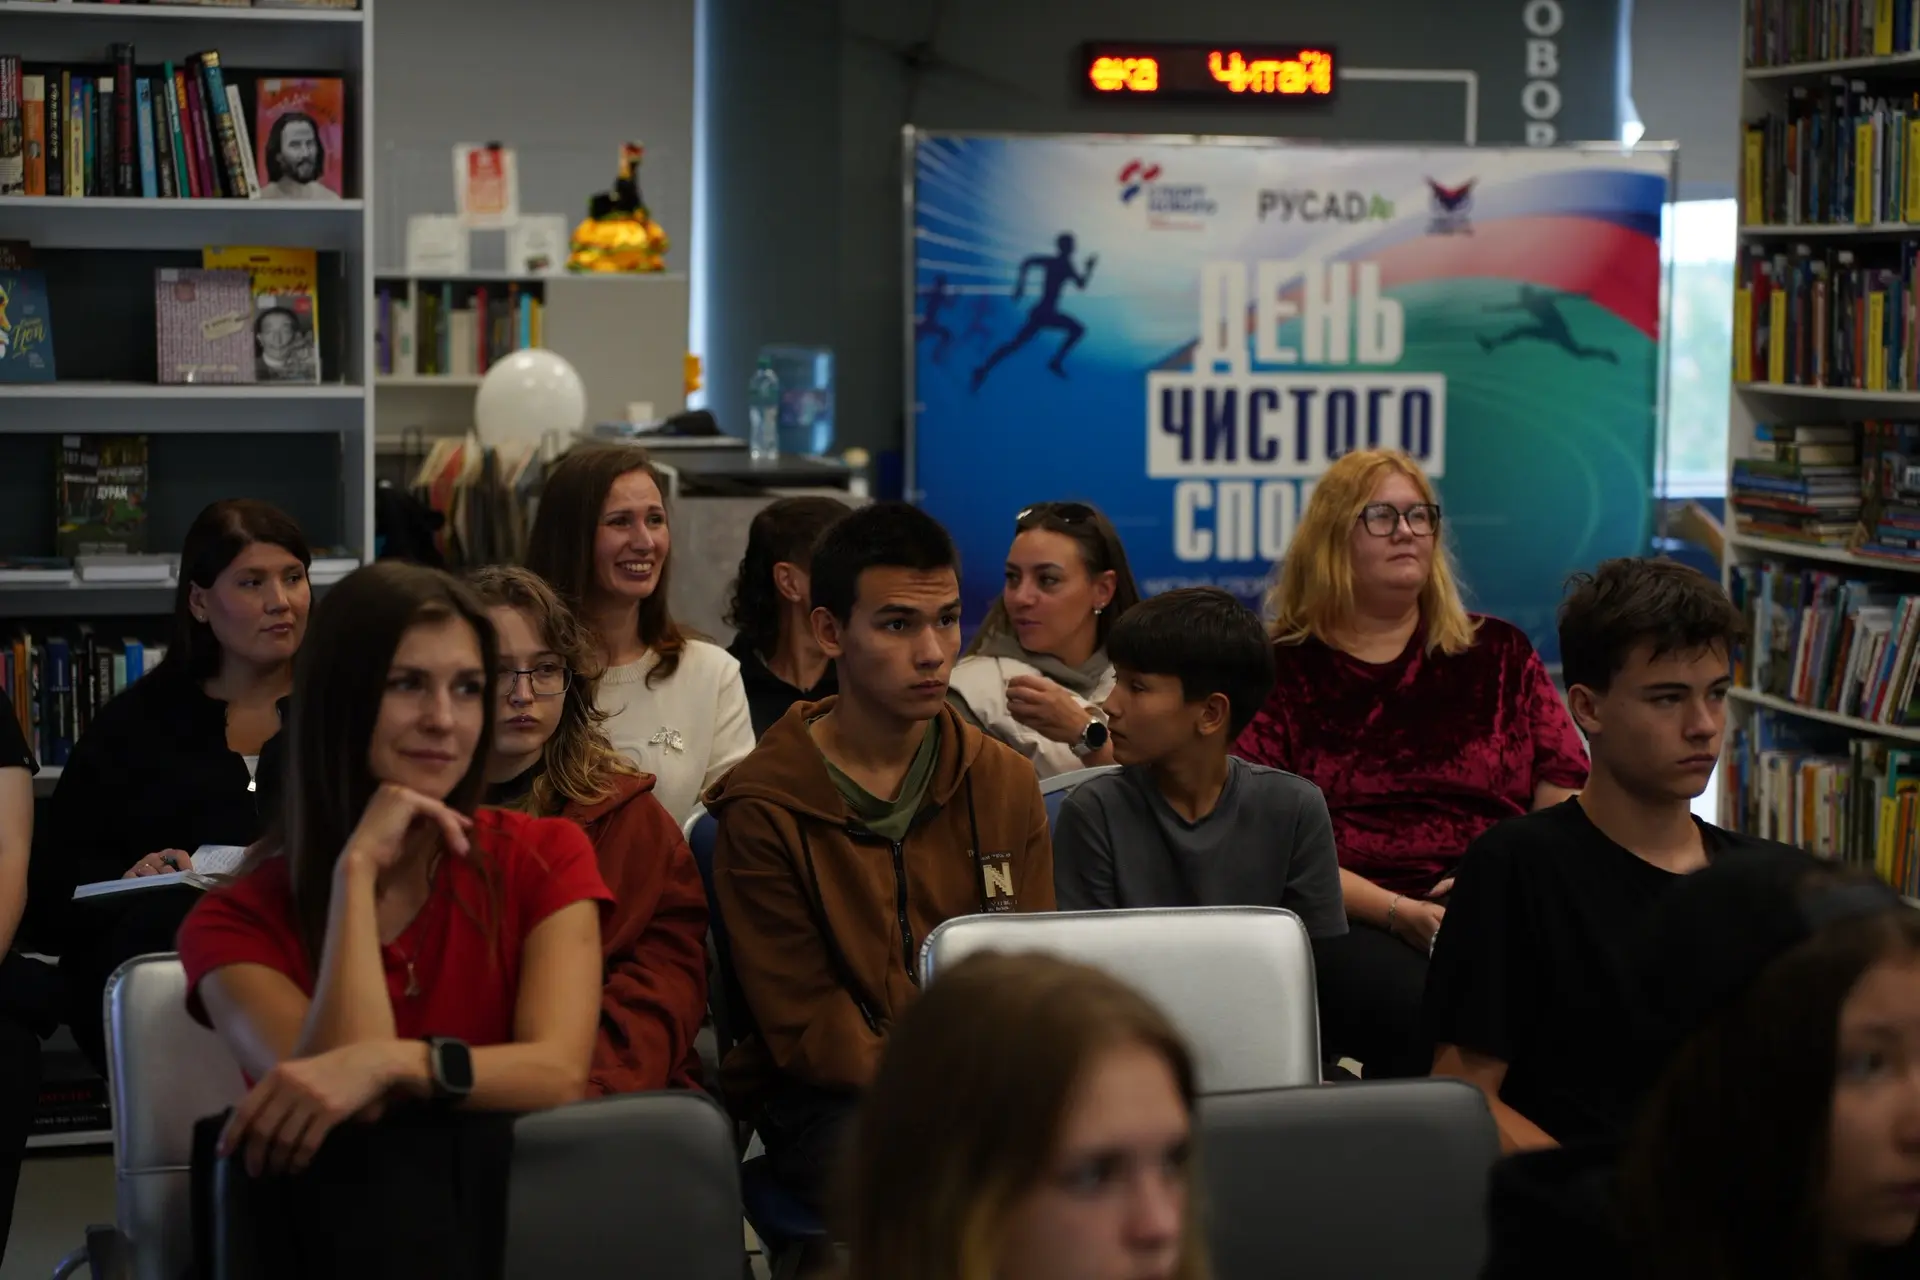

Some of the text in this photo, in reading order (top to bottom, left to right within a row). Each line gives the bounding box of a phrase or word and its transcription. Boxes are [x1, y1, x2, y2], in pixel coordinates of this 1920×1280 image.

[1208, 51, 1331, 94] Читай
[1192, 260, 1405, 373] ДЕНЬ
[1160, 387, 1433, 463] ЧИСТОГО
[1173, 480, 1318, 562] СПО
[983, 862, 1014, 898] N
